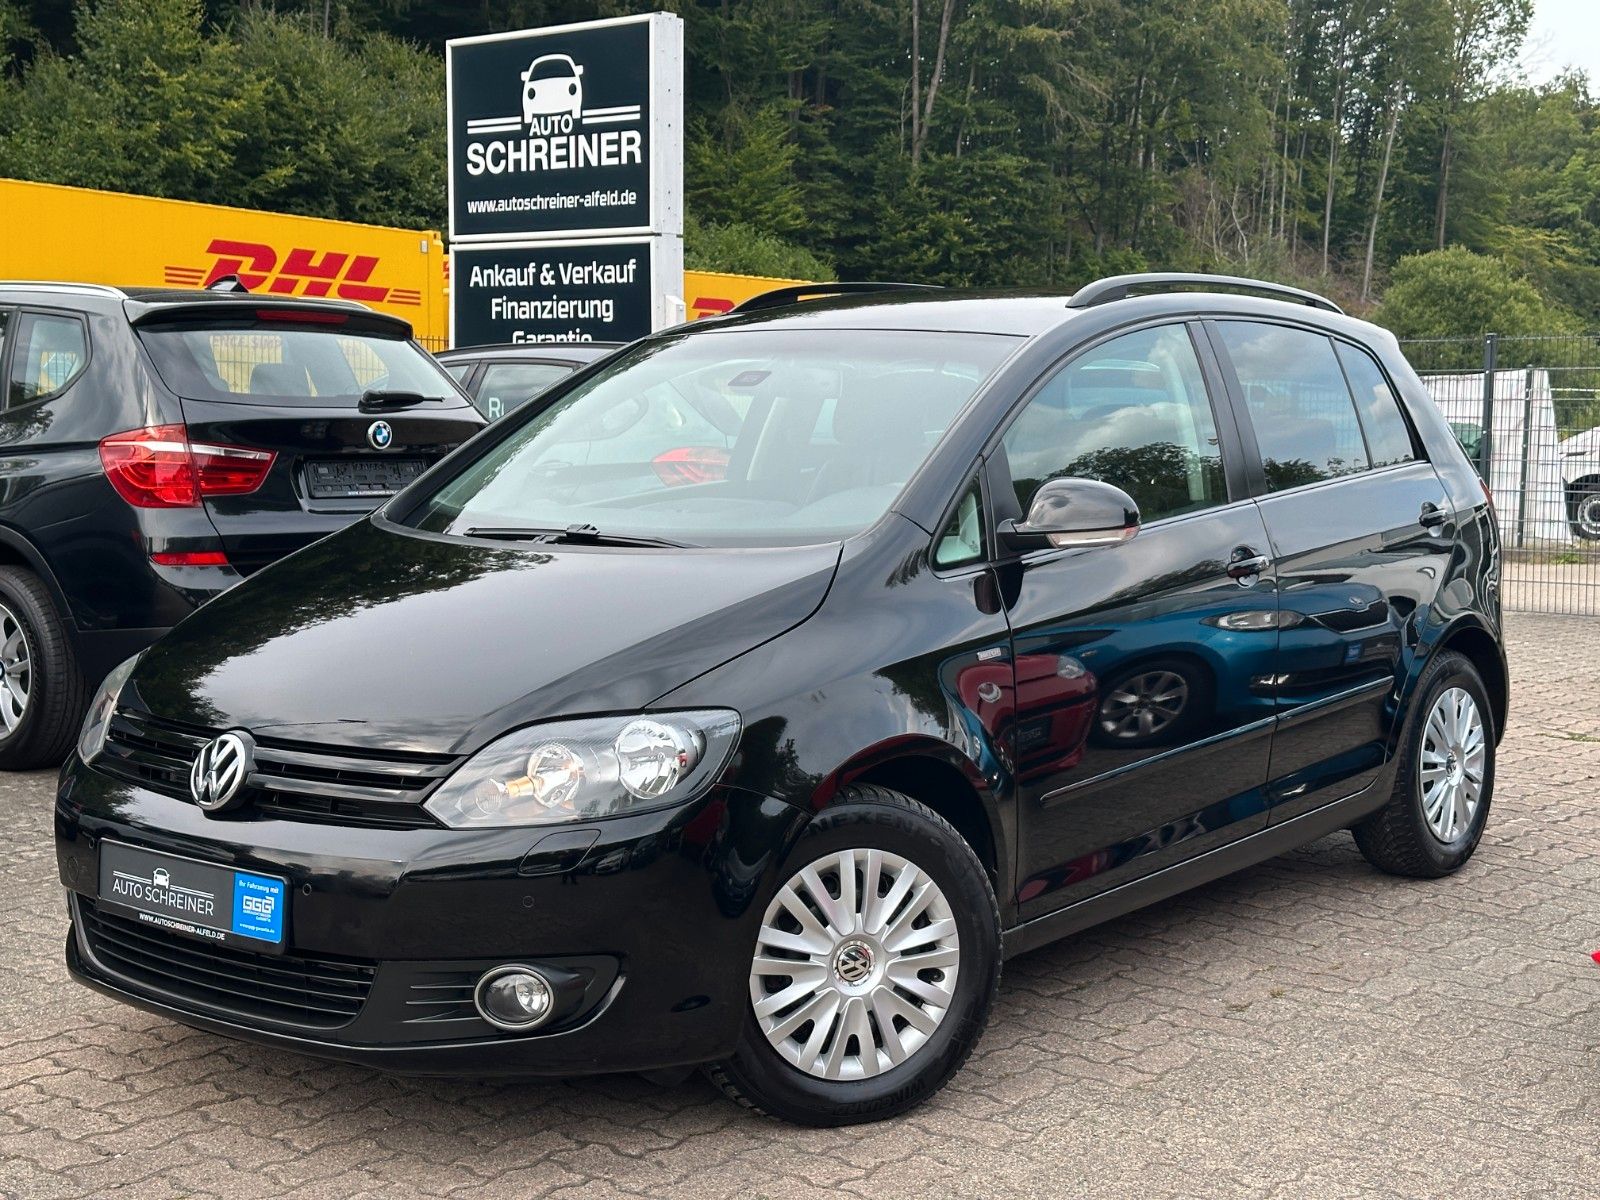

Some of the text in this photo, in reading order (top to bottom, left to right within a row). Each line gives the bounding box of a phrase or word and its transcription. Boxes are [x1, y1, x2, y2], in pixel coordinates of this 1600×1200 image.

[529, 114, 573, 136] AUTO
[466, 130, 642, 176] SCHREINER
[467, 189, 637, 214] www.autoschreiner-alfeld.de
[203, 239, 390, 302] DHL
[469, 258, 637, 287] Ankauf & Verkauf
[491, 295, 613, 322] Finanzierung
[112, 879, 215, 917] AUTO SCHREINER
[139, 912, 226, 941] WWW.AUTOSCHREINER-ALFELD.DE
